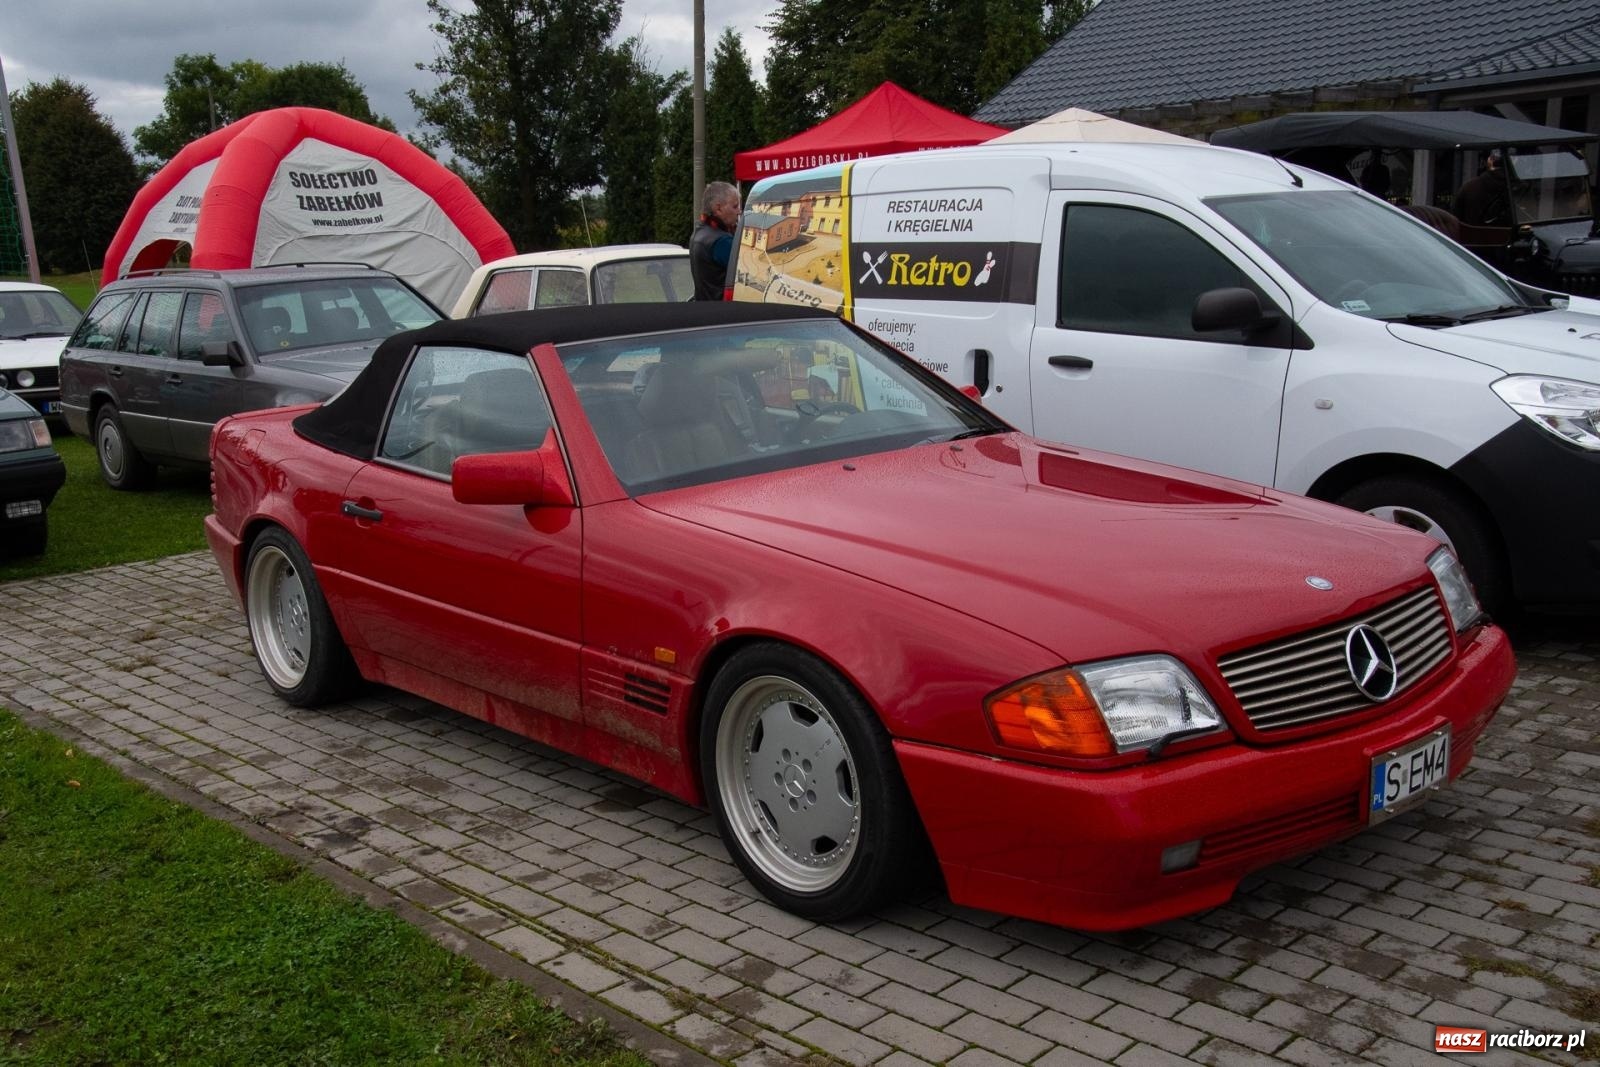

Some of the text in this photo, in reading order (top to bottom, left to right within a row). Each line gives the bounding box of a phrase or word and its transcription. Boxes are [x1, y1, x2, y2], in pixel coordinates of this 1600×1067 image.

[288, 168, 378, 190] SOŁECTWO
[296, 191, 383, 213] ZABEŁKÓW
[886, 198, 984, 214] RESTAURACJA
[887, 218, 974, 236] I KRĘGIELNIA
[886, 252, 972, 287] Retro
[867, 318, 917, 336] oferujemy:
[1373, 737, 1447, 805] PL S EM4
